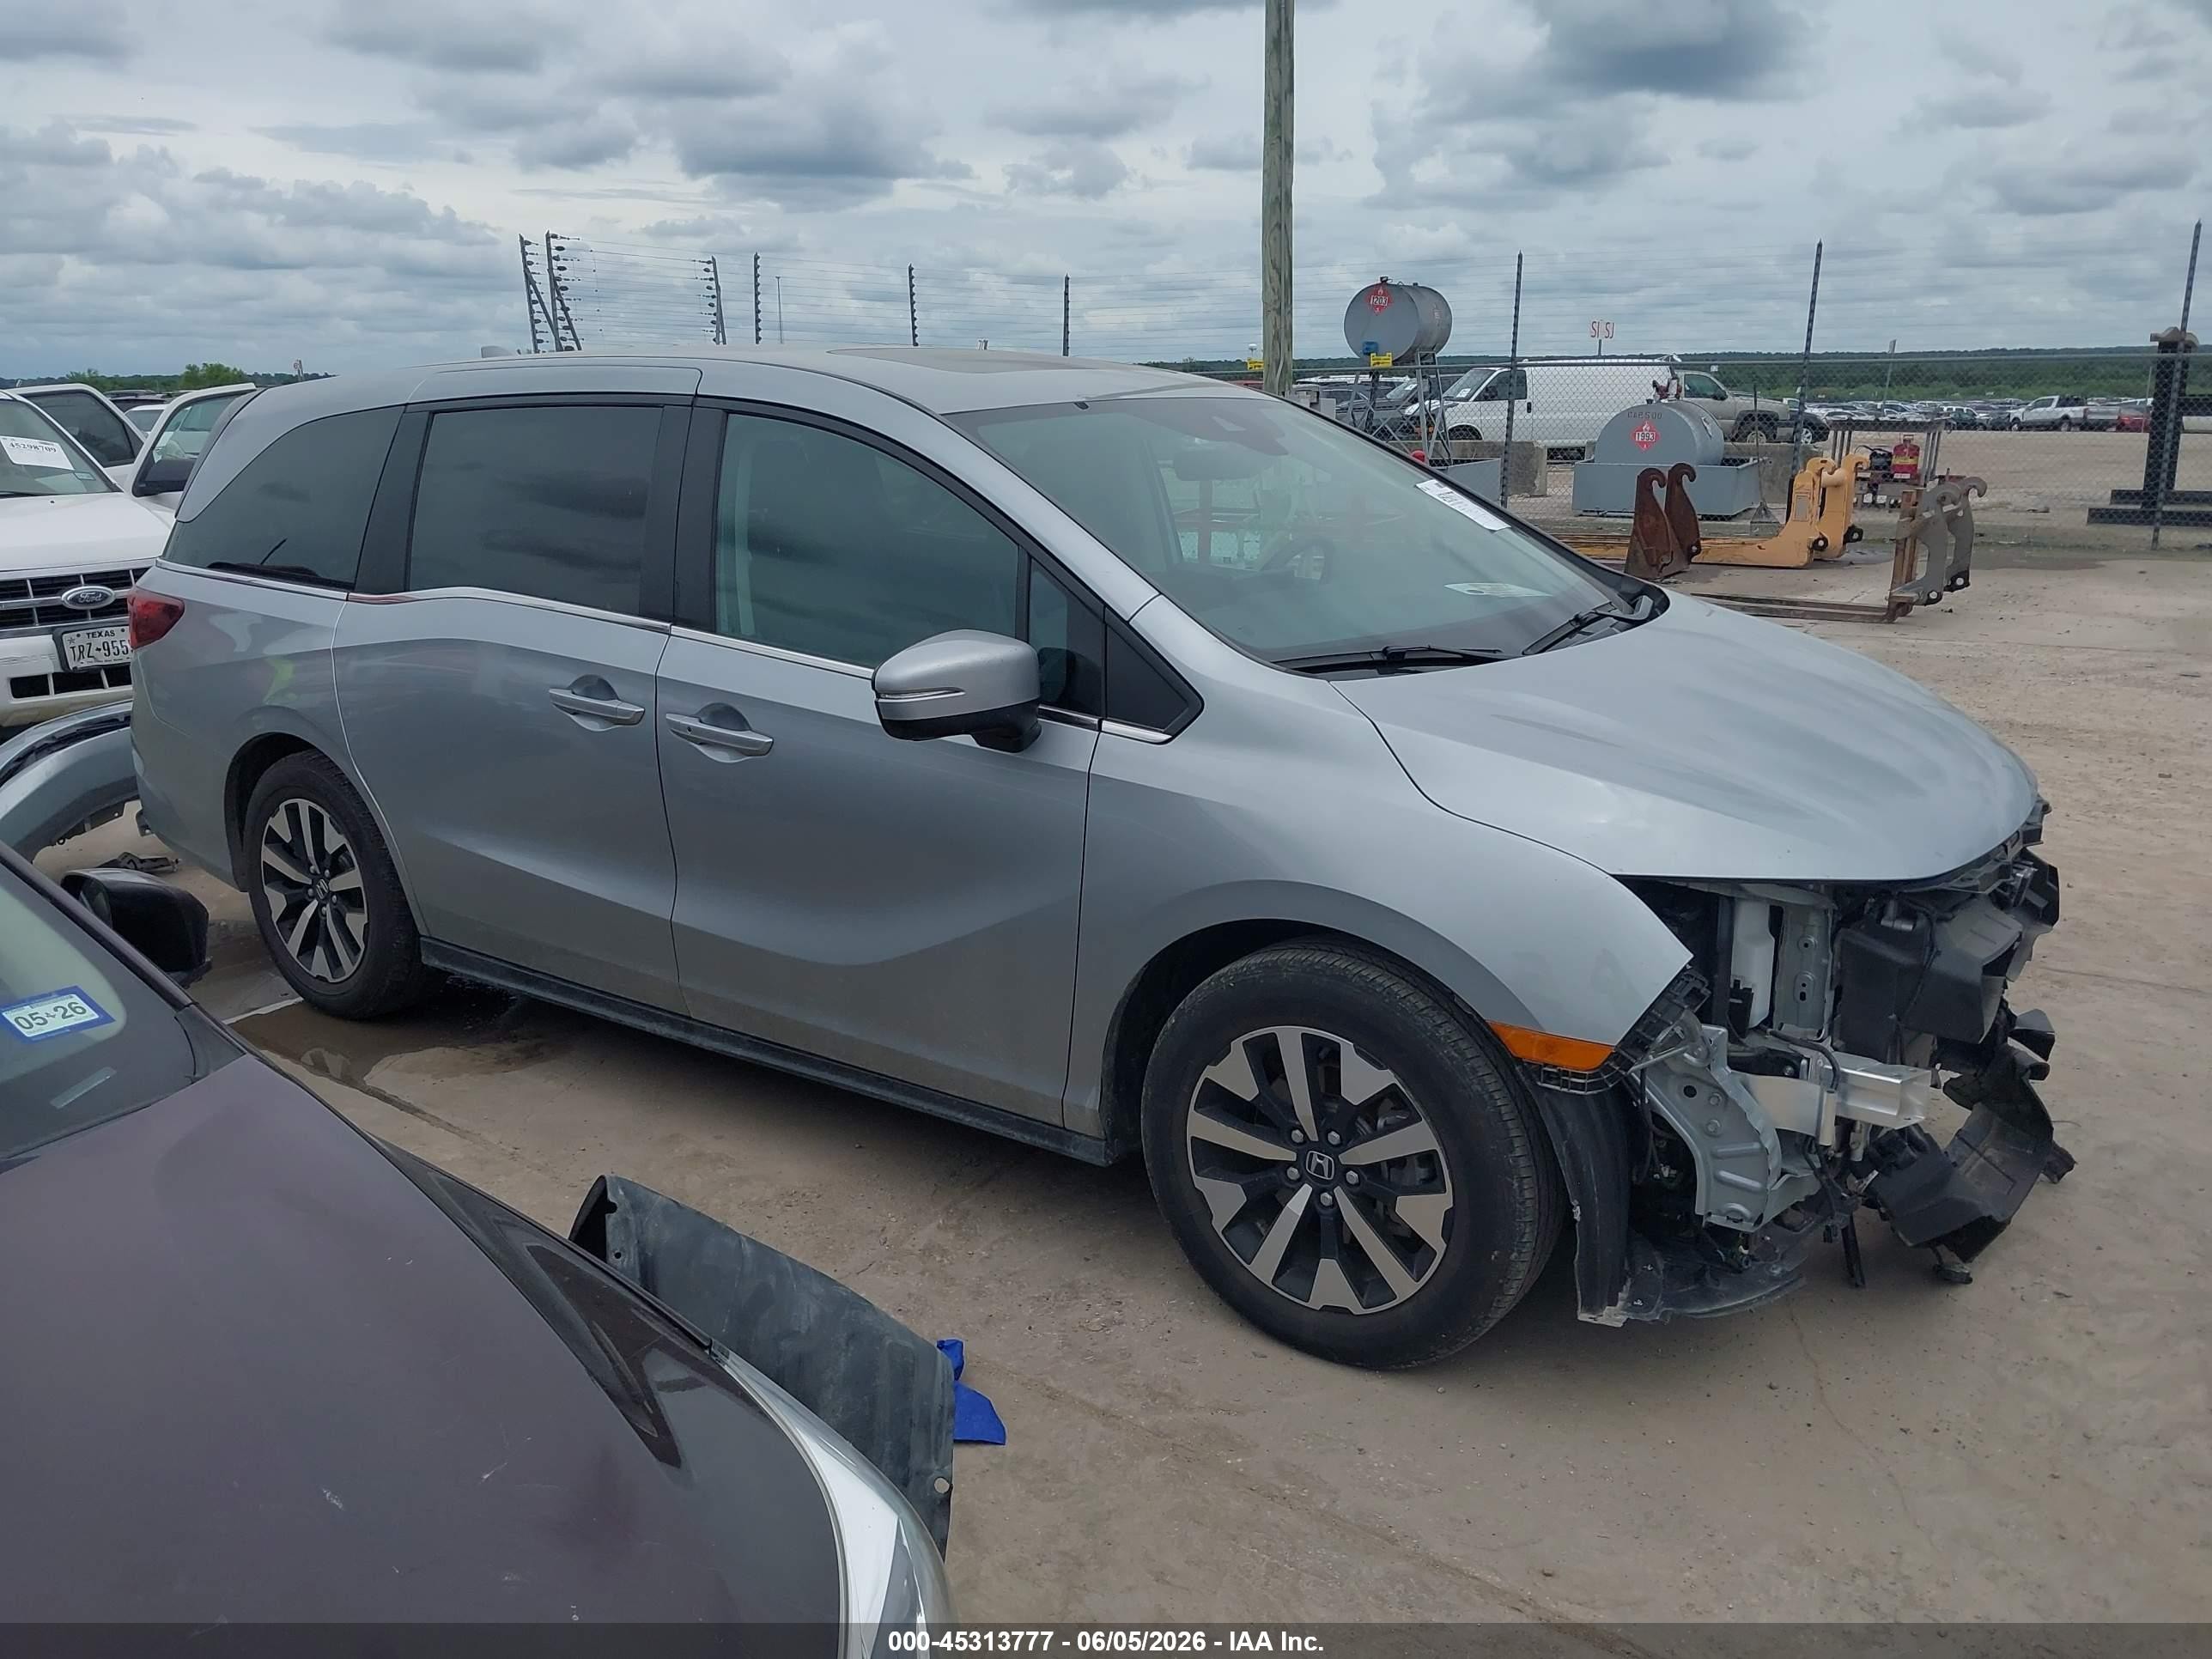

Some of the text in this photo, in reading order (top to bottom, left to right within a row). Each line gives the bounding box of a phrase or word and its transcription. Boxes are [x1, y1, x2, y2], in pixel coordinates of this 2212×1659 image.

[1370, 296, 1387, 306] 1203
[1637, 432, 1655, 441] 1993
[78, 591, 102, 603] Ford
[87, 629, 115, 639] TEXAS
[102, 639, 132, 657] 955
